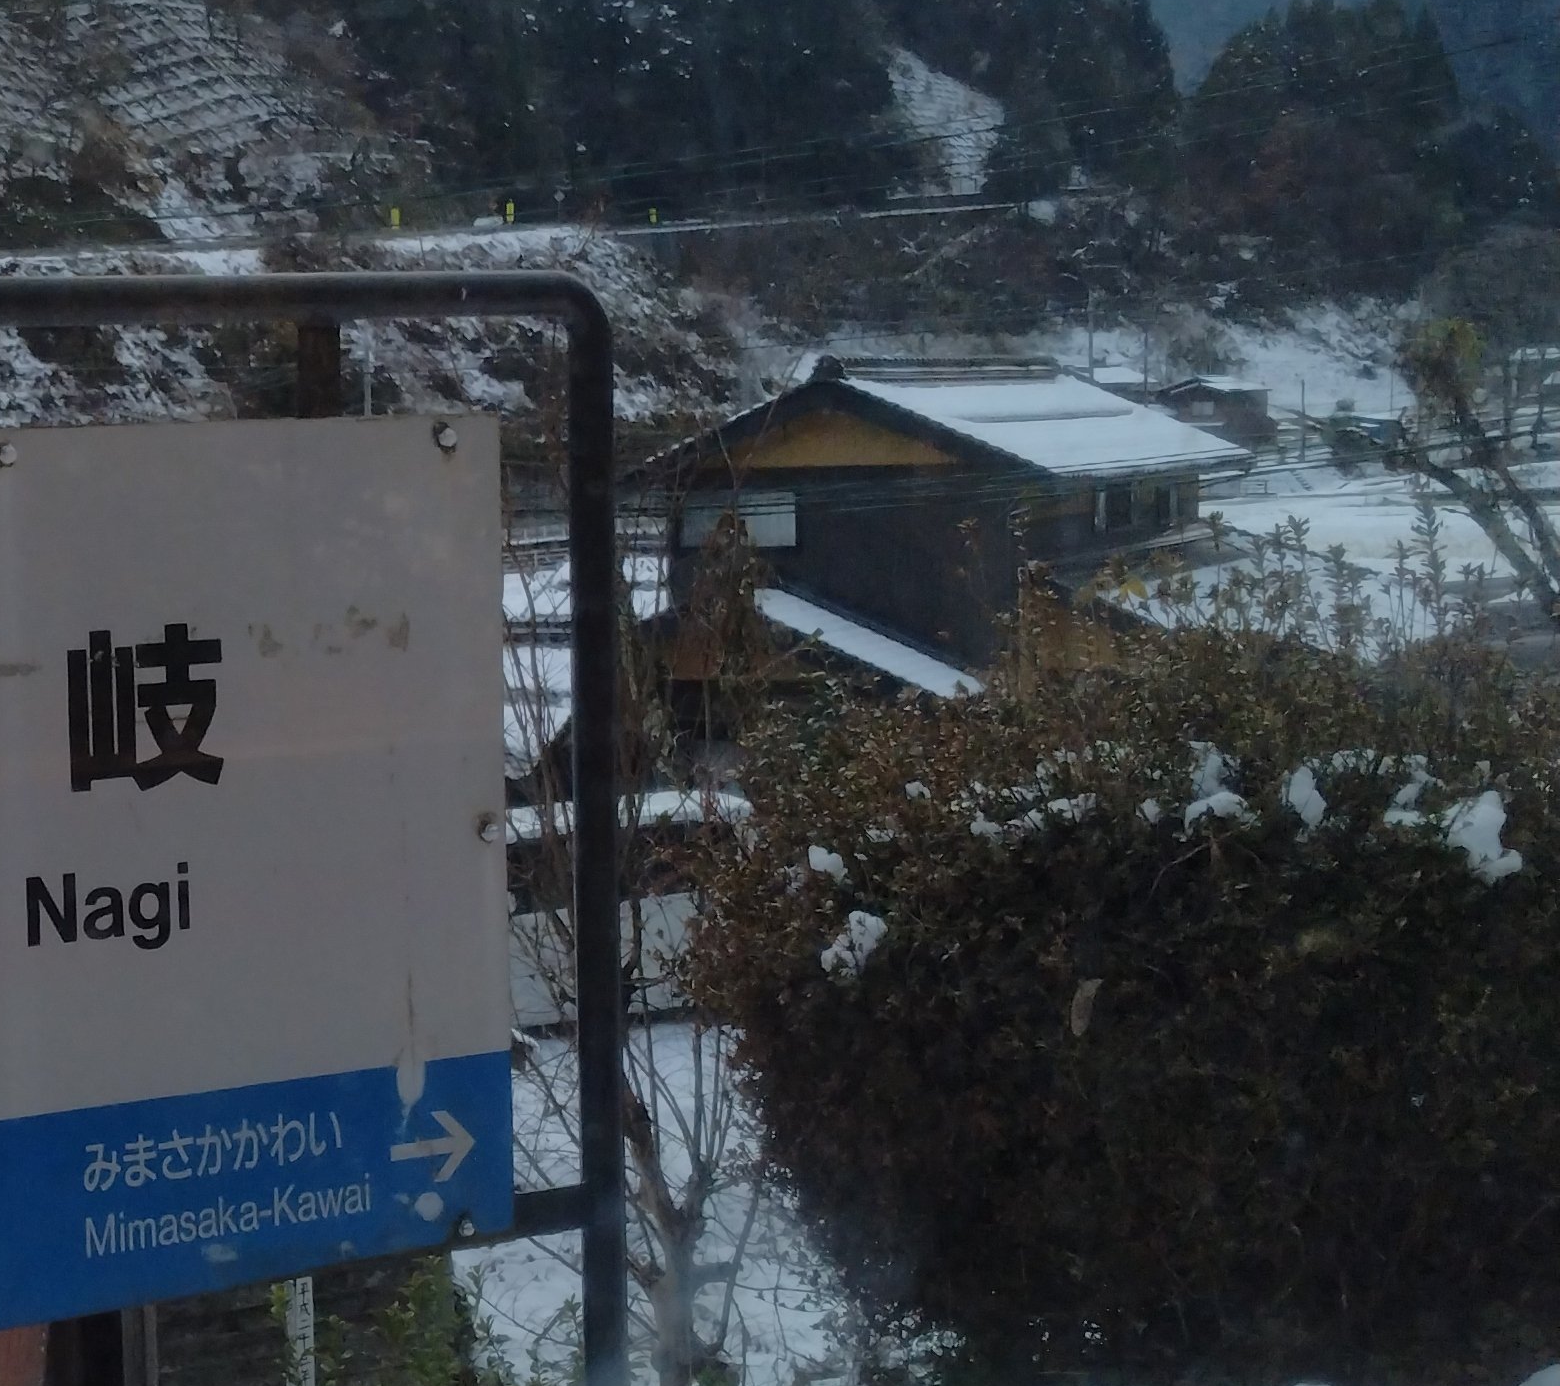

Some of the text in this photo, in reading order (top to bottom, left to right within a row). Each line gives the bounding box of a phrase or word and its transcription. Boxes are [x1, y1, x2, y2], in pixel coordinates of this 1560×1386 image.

[25, 861, 191, 950] Nagi
[82, 1111, 343, 1193] みまさかかわい
[84, 1171, 372, 1259] Mimasaka-Kawai
